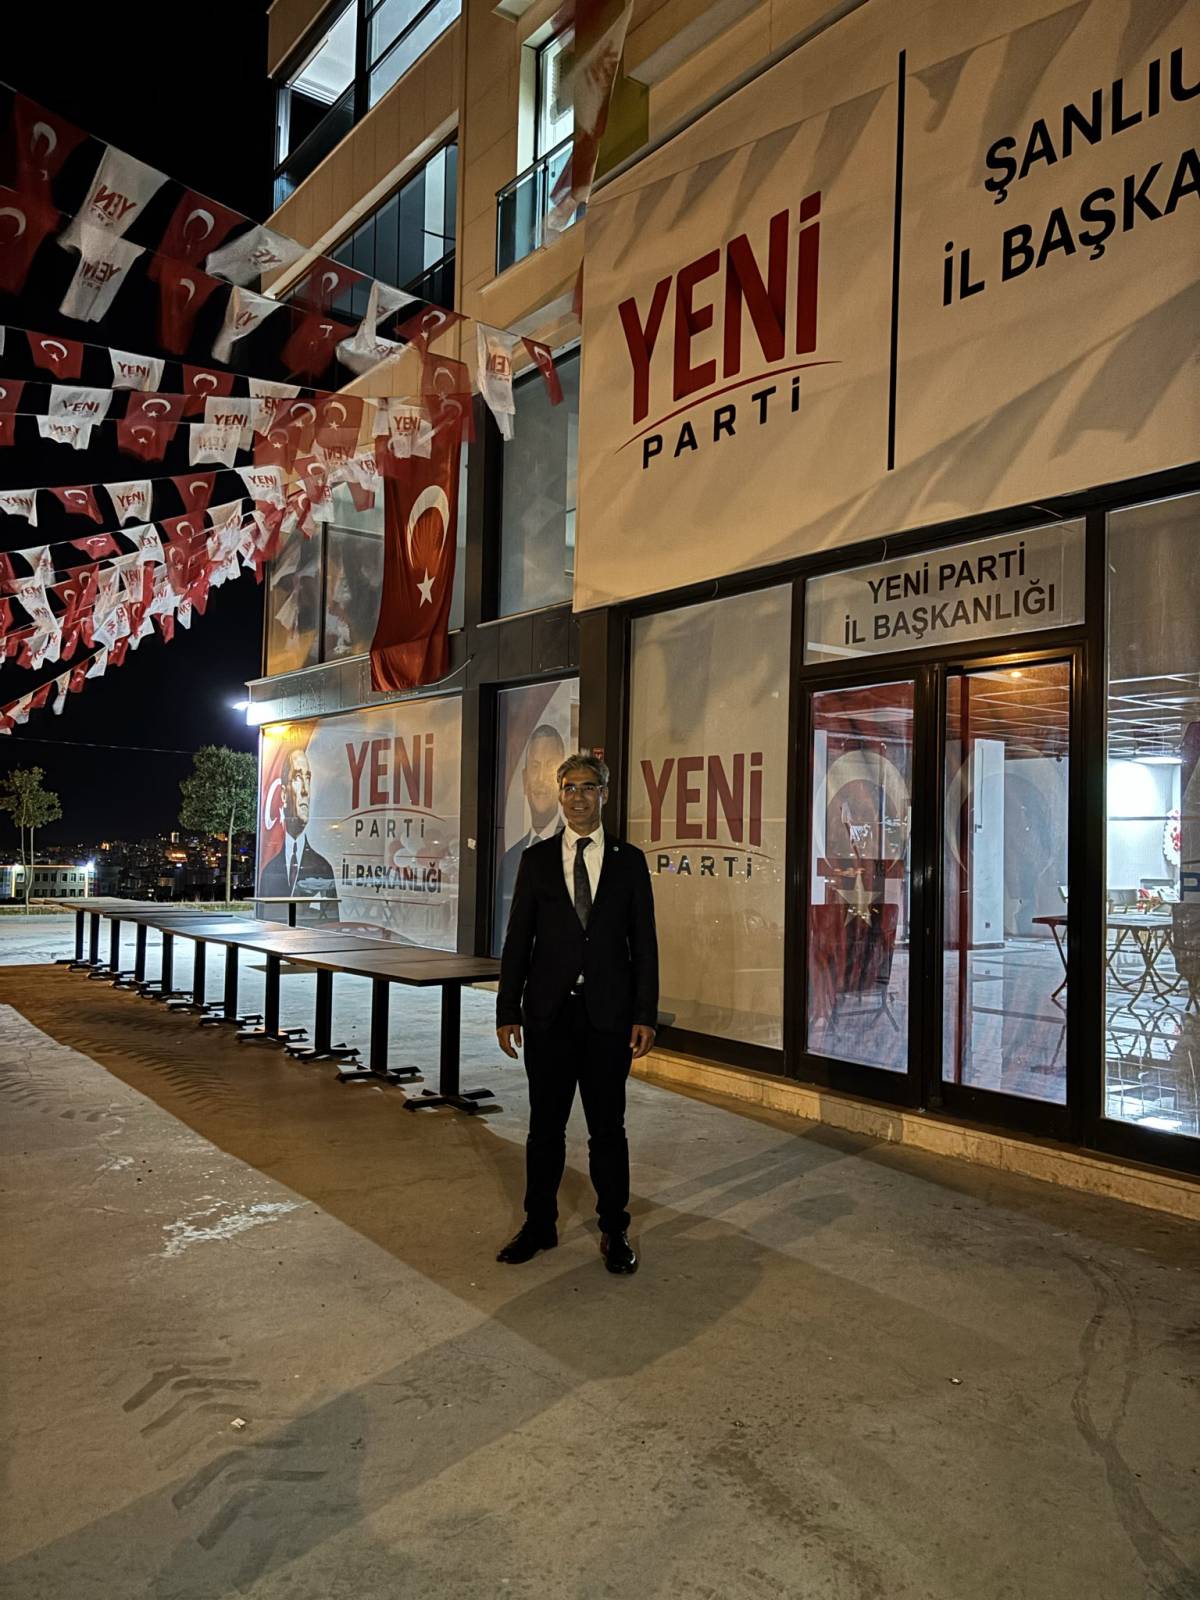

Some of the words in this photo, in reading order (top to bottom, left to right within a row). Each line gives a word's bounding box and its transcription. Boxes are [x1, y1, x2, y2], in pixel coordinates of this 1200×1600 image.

[943, 241, 985, 306] İL
[868, 562, 929, 604] YENİ
[939, 542, 1025, 591] PARTİ
[845, 615, 866, 645] İL
[874, 579, 1055, 640] BAŞKANLIĞI
[356, 862, 442, 893] BAŞKANLIĞI
